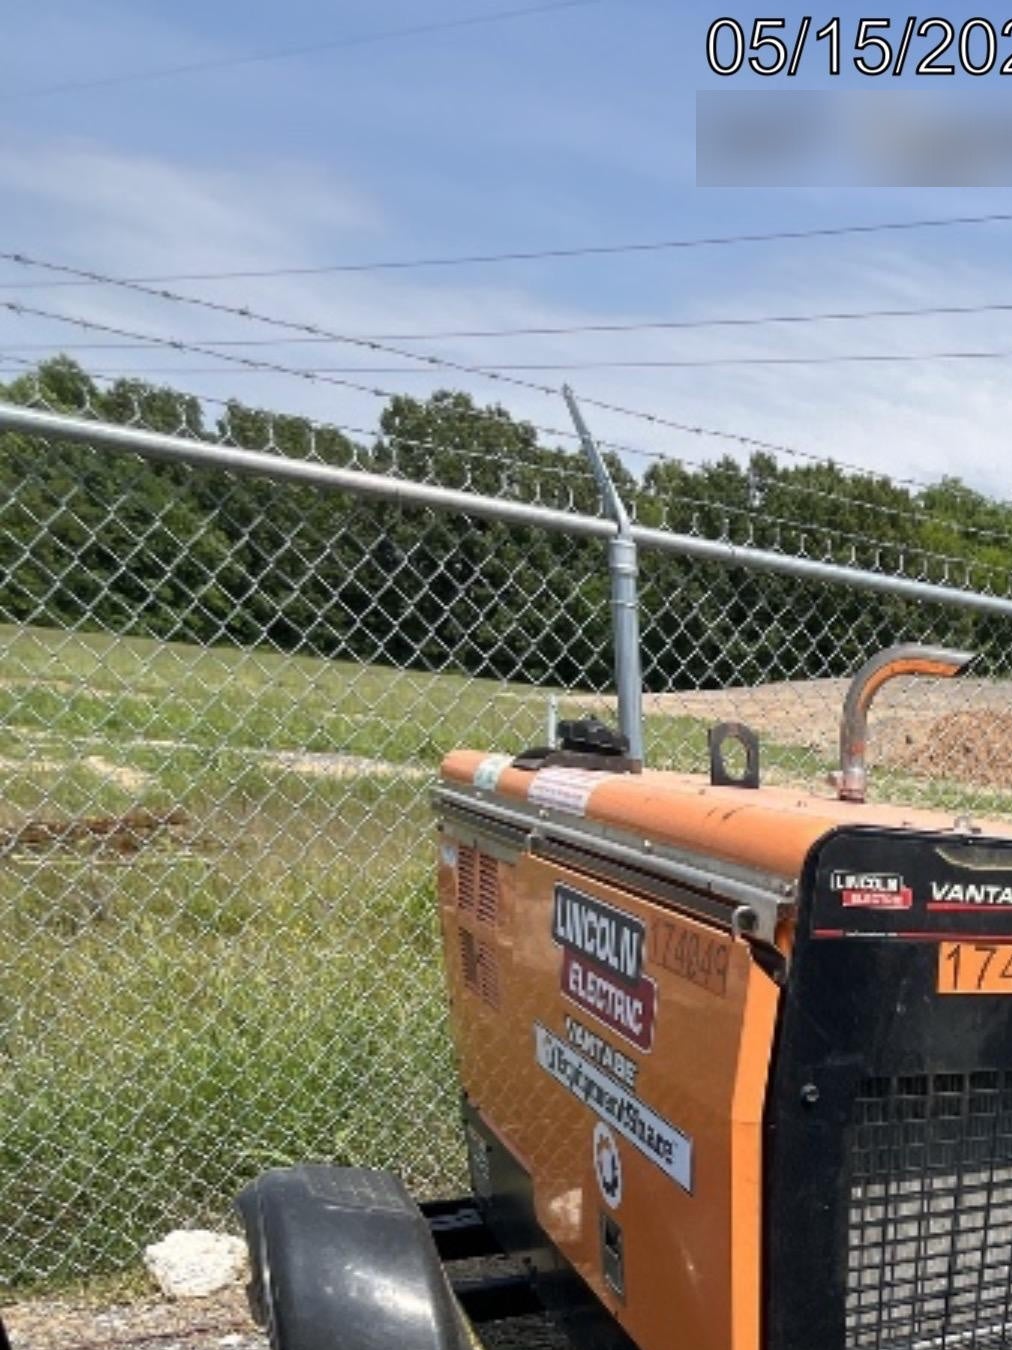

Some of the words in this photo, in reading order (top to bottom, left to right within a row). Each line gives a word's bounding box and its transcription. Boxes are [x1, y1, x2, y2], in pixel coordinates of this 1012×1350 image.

[836, 874, 899, 892] LINCOLN
[556, 893, 641, 980] LINCOLN
[568, 961, 643, 1036] ELECTRIC
[565, 1016, 638, 1088] VANTAGE
